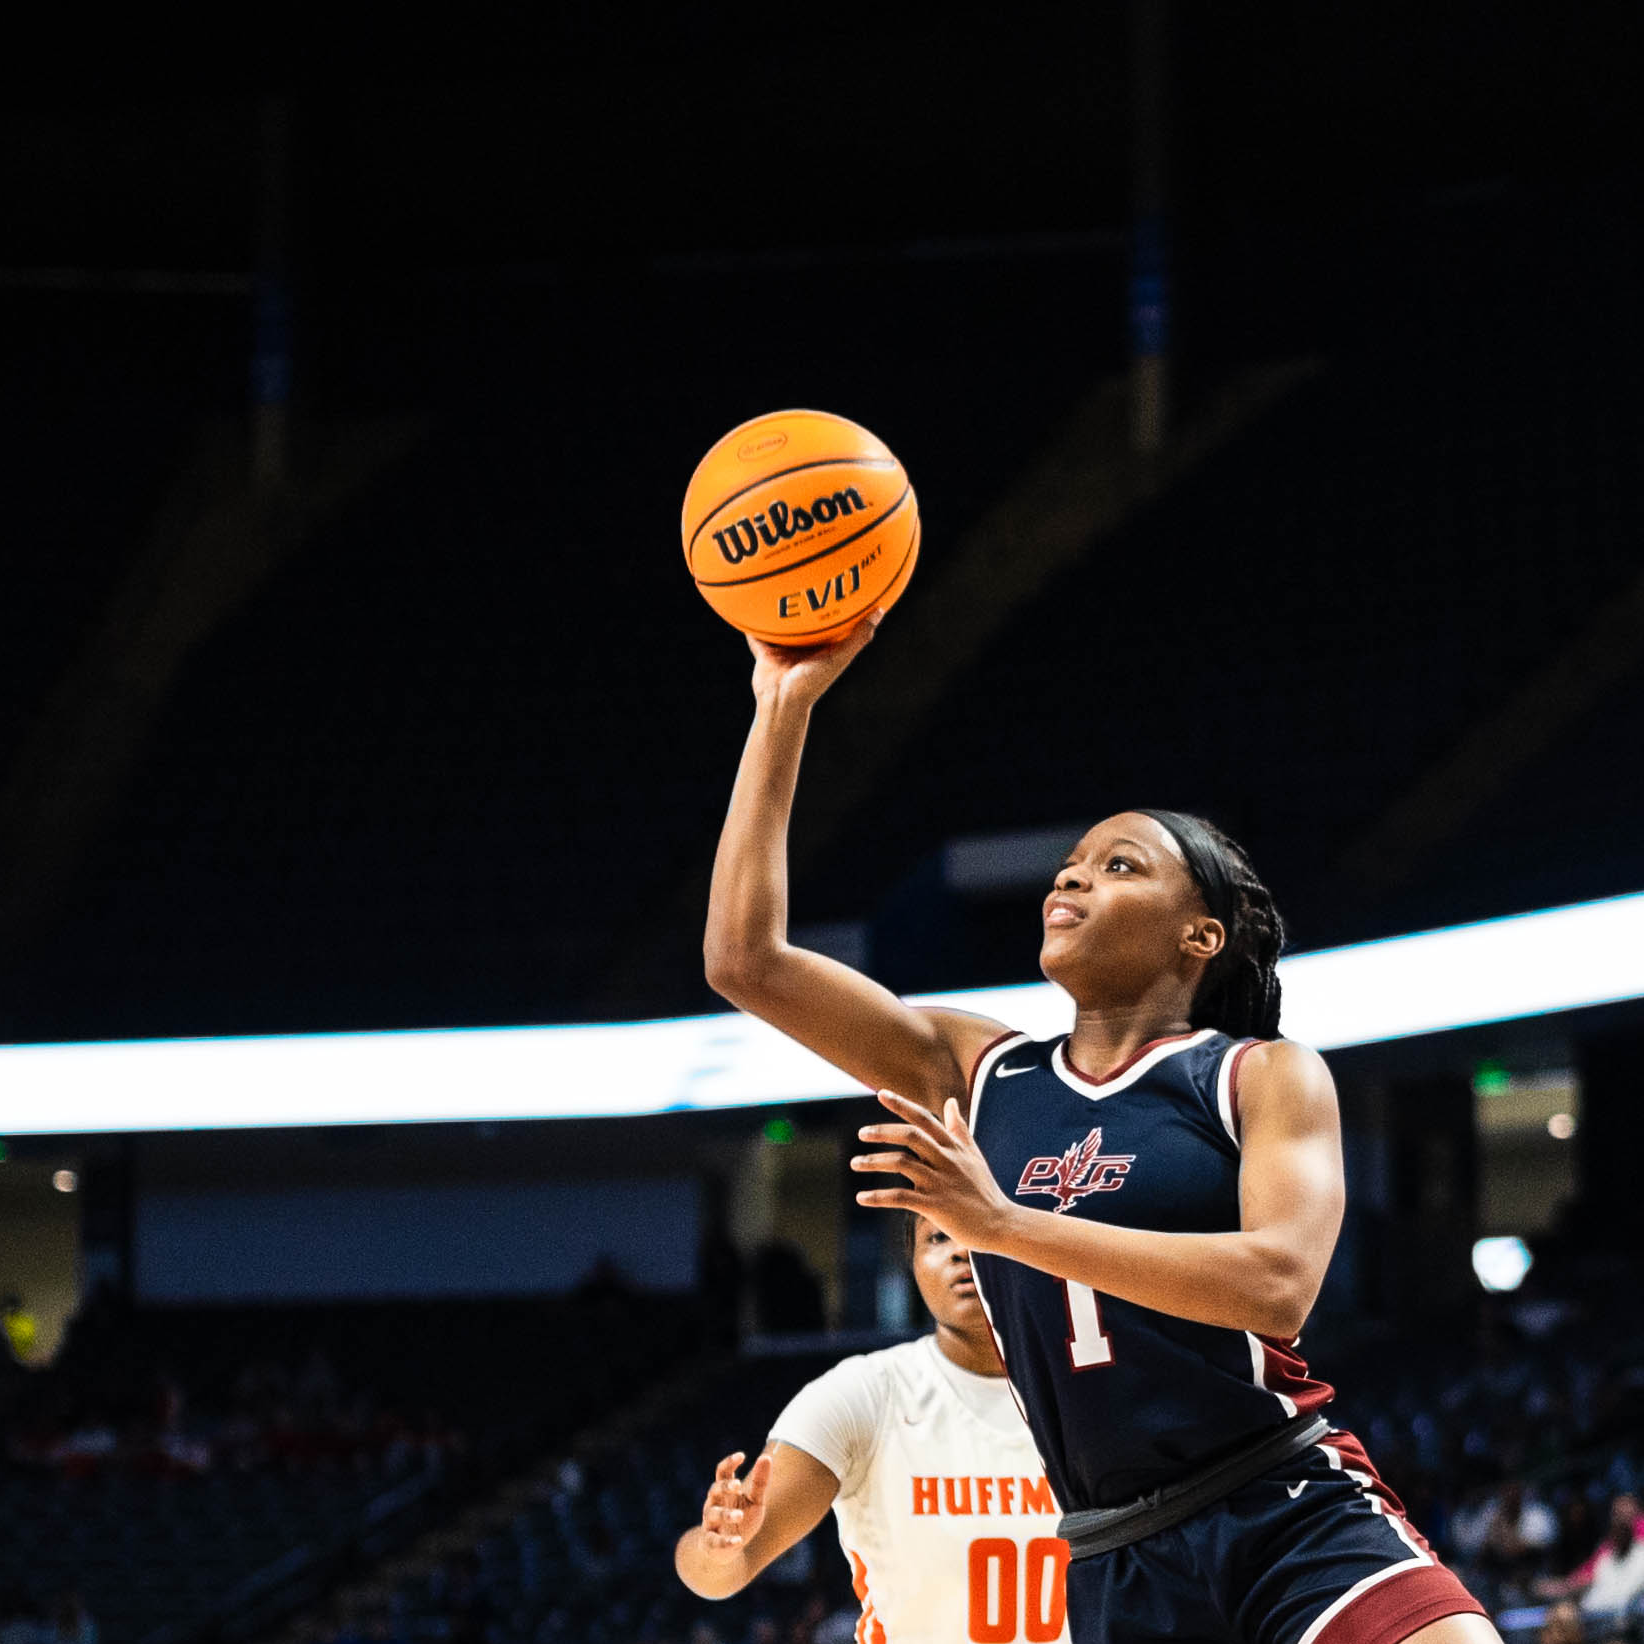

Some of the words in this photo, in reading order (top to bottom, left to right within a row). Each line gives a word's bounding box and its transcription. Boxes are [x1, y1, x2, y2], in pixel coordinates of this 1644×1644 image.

[712, 487, 867, 564] Wilson
[1063, 1278, 1114, 1371] 1
[911, 1476, 1056, 1516] HUFFM
[968, 1537, 1071, 1644] 00
